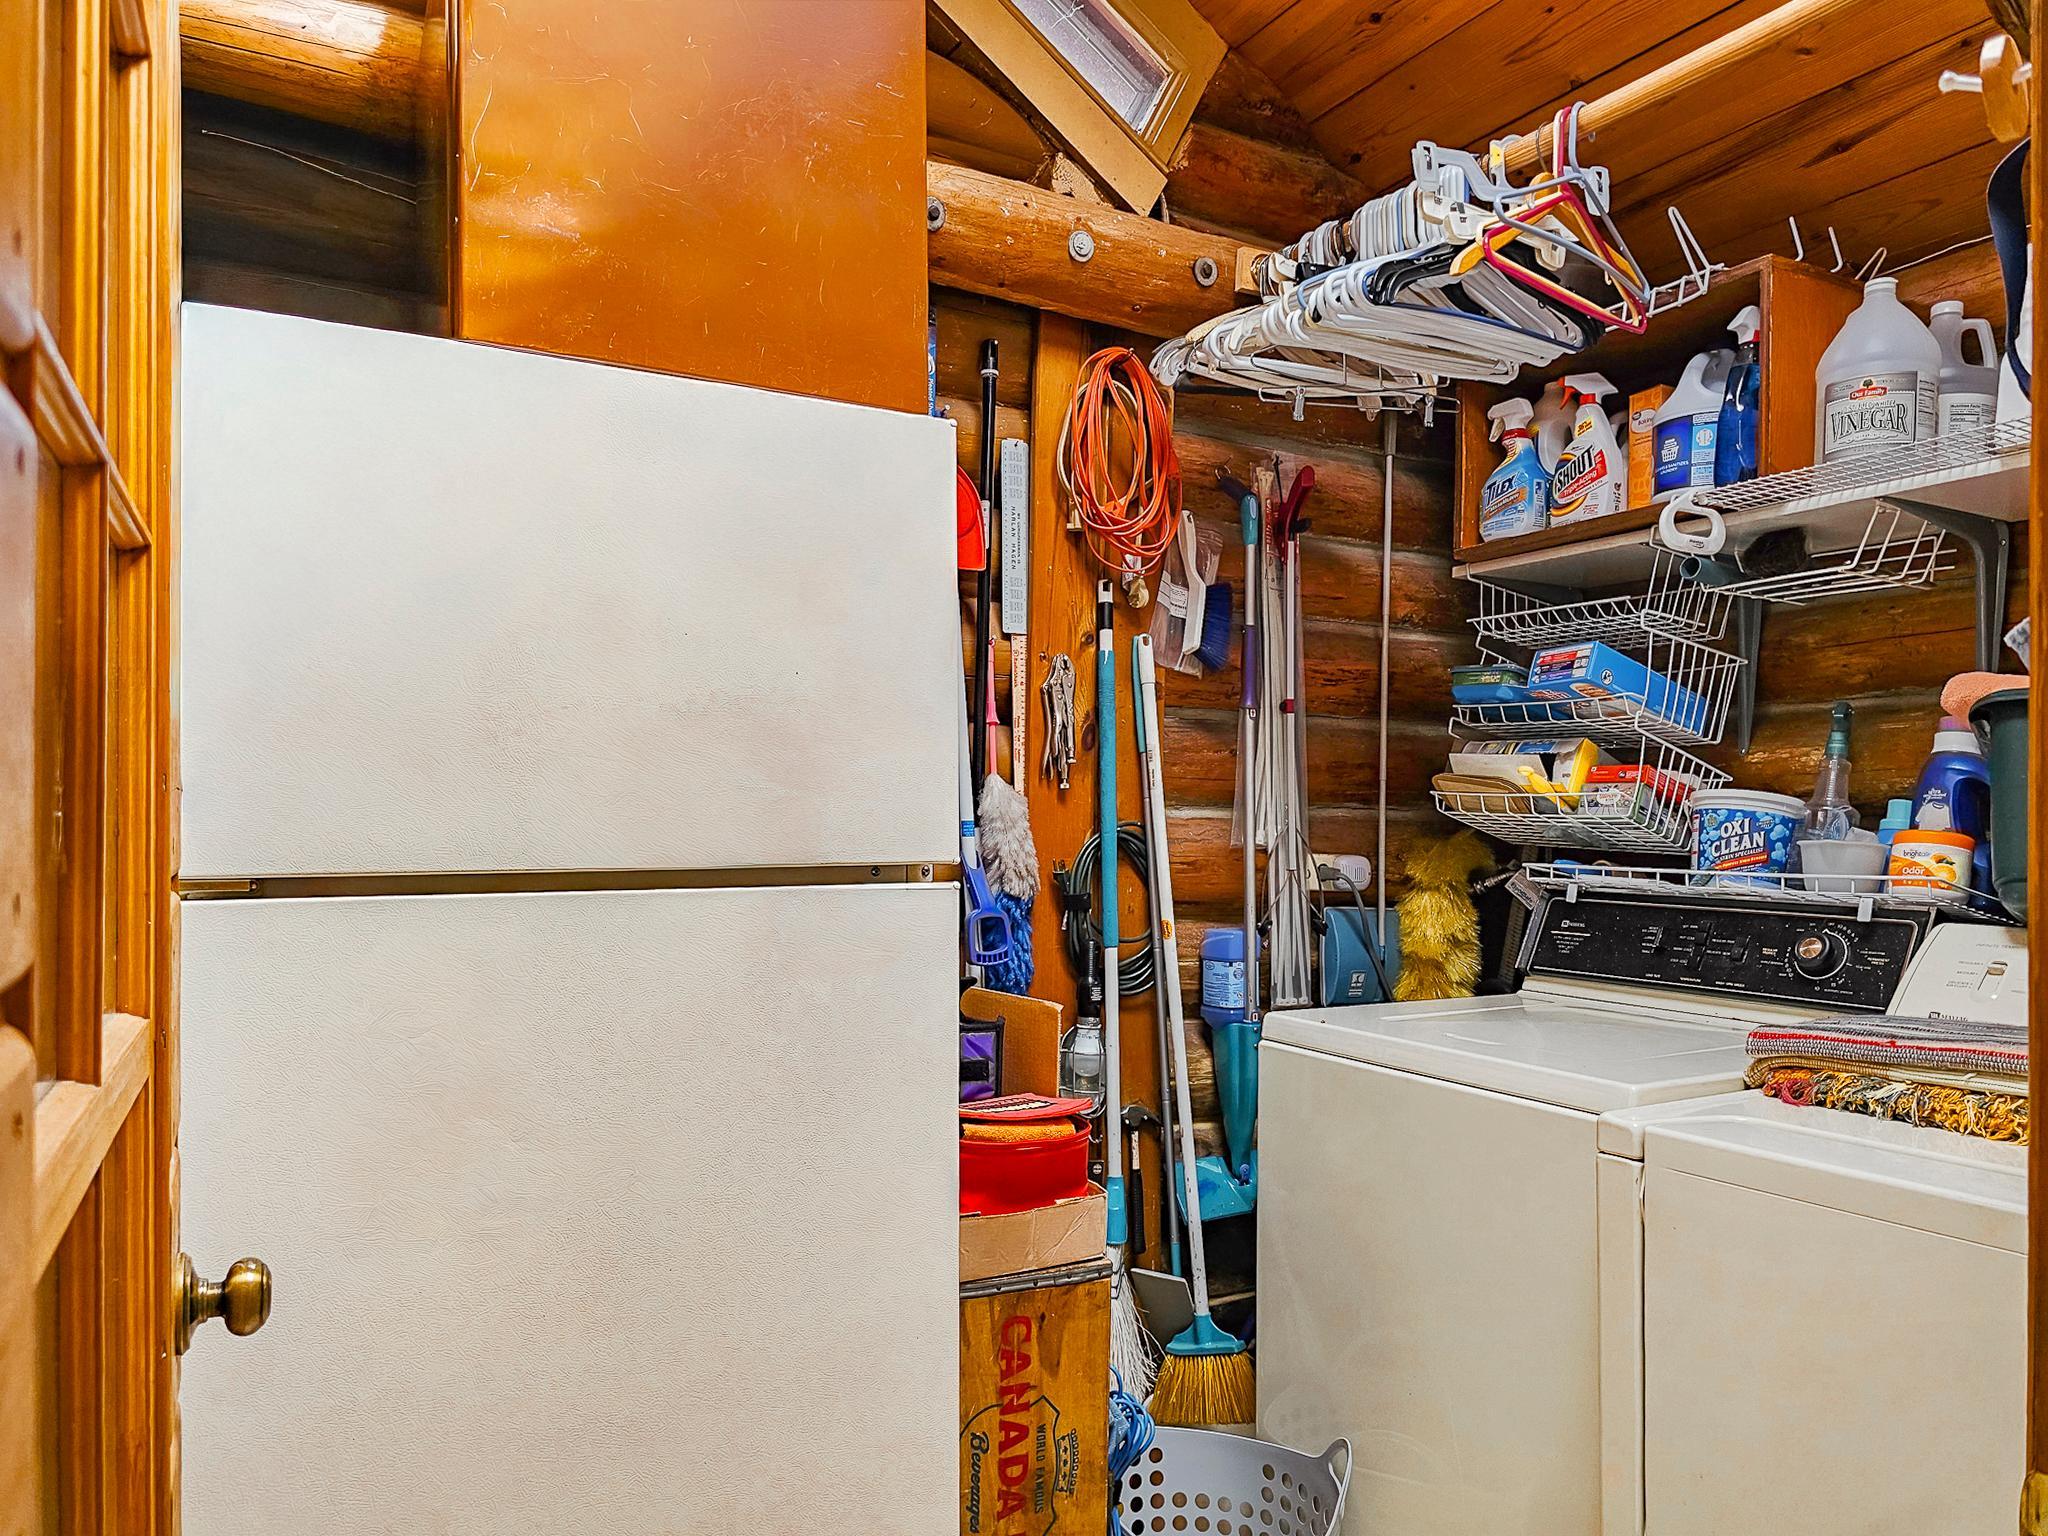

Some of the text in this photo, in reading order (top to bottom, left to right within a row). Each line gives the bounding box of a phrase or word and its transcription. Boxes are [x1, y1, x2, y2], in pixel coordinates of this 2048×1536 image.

[1865, 388, 1885, 398] Family
[1831, 402, 1909, 443] VINEGAR
[1557, 445, 1595, 492] SHOUT
[1484, 473, 1517, 506] TILEX
[1720, 817, 1751, 838] OXI
[1711, 831, 1766, 858] CLEAN
[1720, 847, 1764, 861] STAIN SPECIALIST
[1902, 866, 1925, 875] Odor
[996, 1315, 1032, 1523] CANADA
[965, 1431, 990, 1535] Beverages
[1033, 1424, 1047, 1514] WORLD FAMOUS
